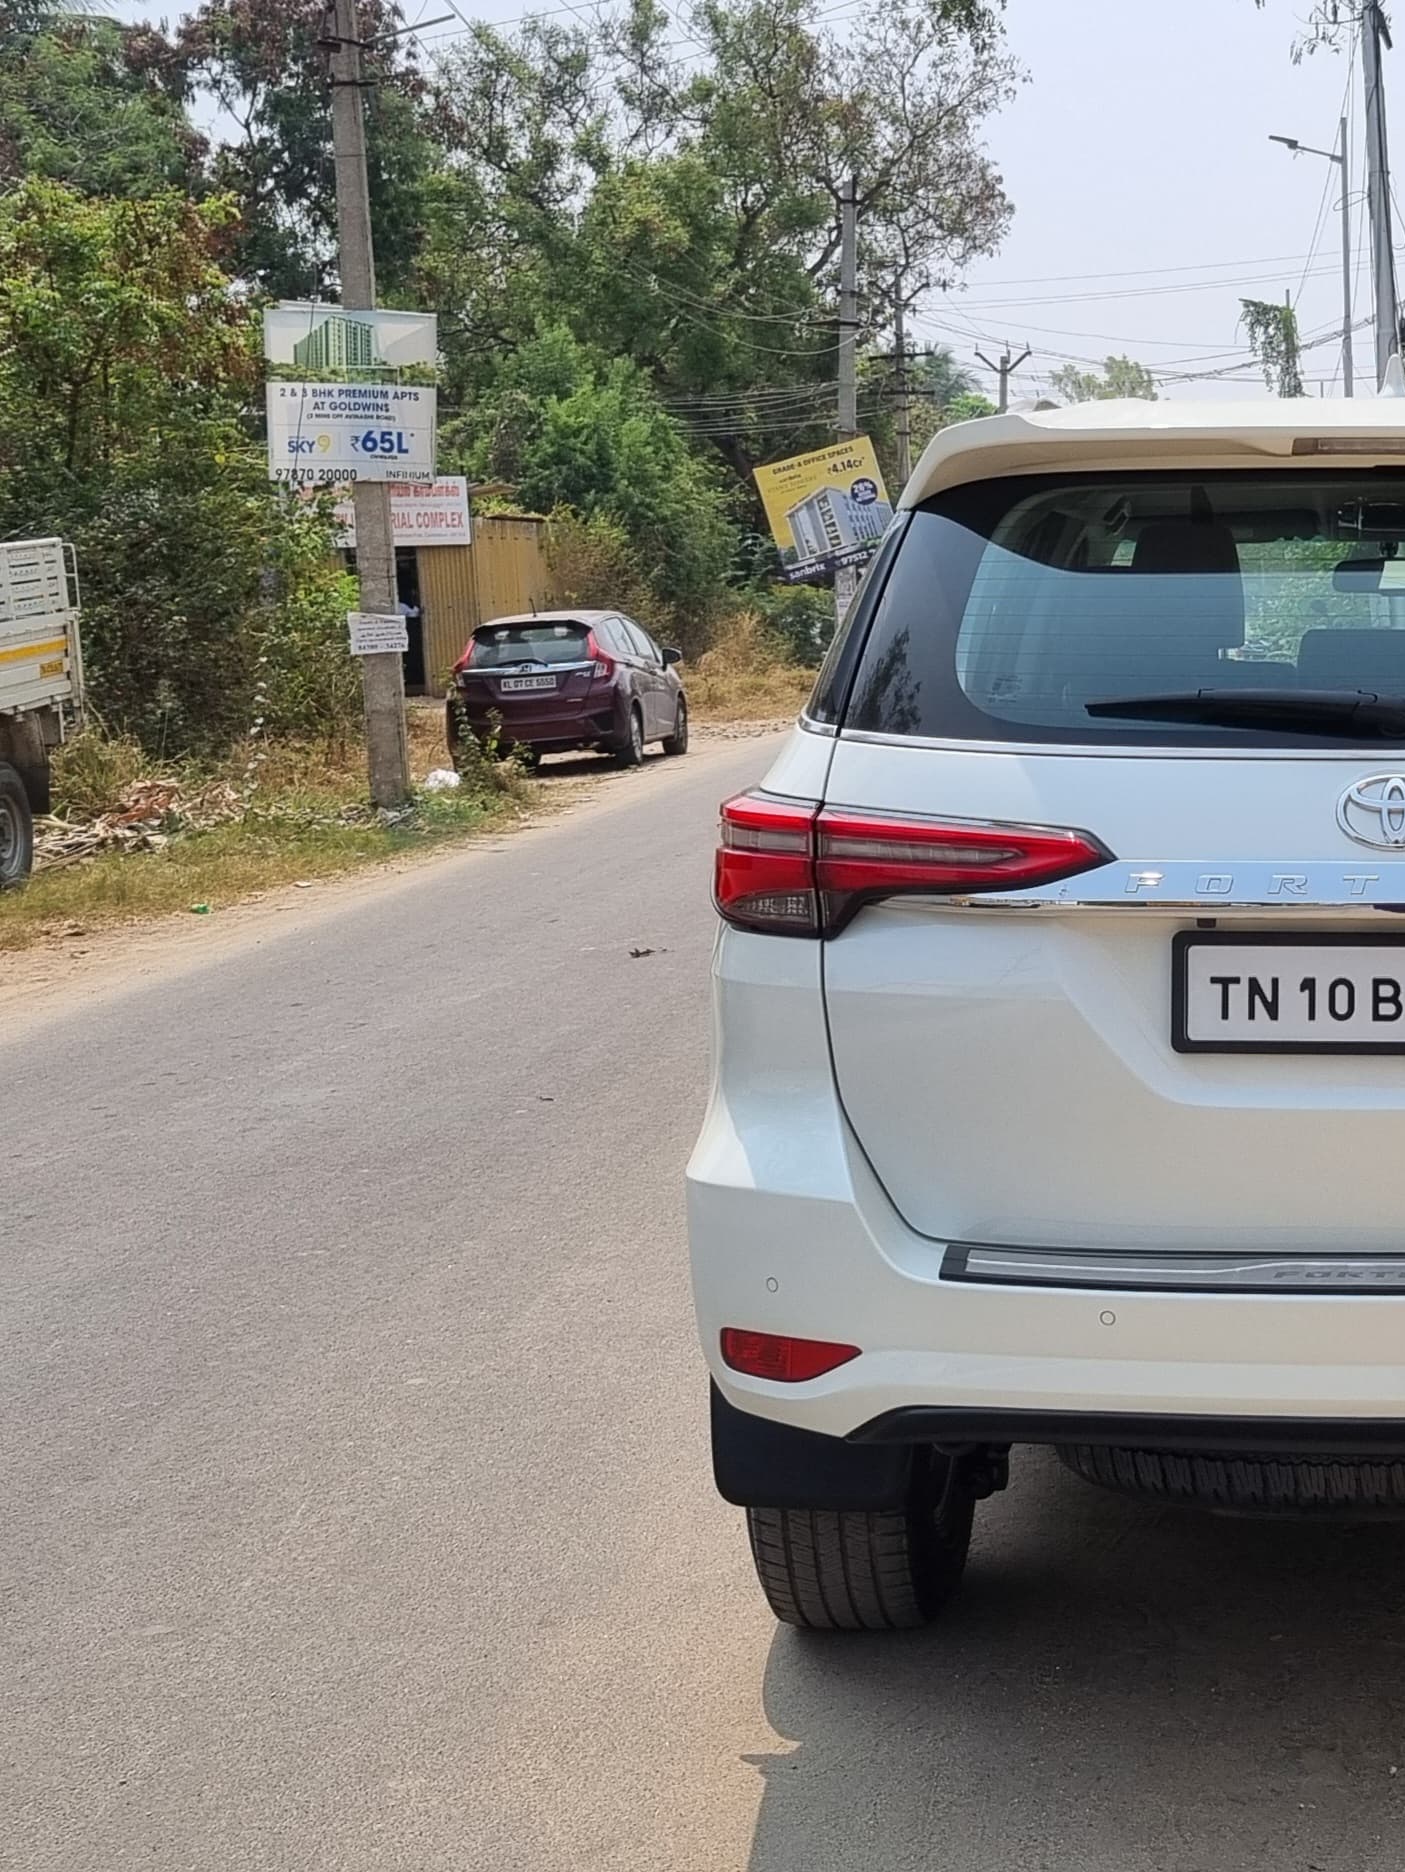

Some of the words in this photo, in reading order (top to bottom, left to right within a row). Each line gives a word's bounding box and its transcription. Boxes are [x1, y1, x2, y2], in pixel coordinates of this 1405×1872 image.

[280, 388, 286, 397] 2
[290, 388, 297, 397] &
[311, 389, 335, 398] BHK
[338, 389, 389, 400] PREMIUM
[392, 391, 420, 401] APTS
[312, 402, 326, 411] AT
[329, 402, 390, 413] GOLDWINS
[288, 440, 315, 453] SKY
[319, 469, 358, 481] 20000
[390, 512, 414, 529] RIAL
[416, 511, 464, 529] COMPLEX
[1209, 976, 1280, 1021] TN
[1299, 977, 1356, 1022] 10
